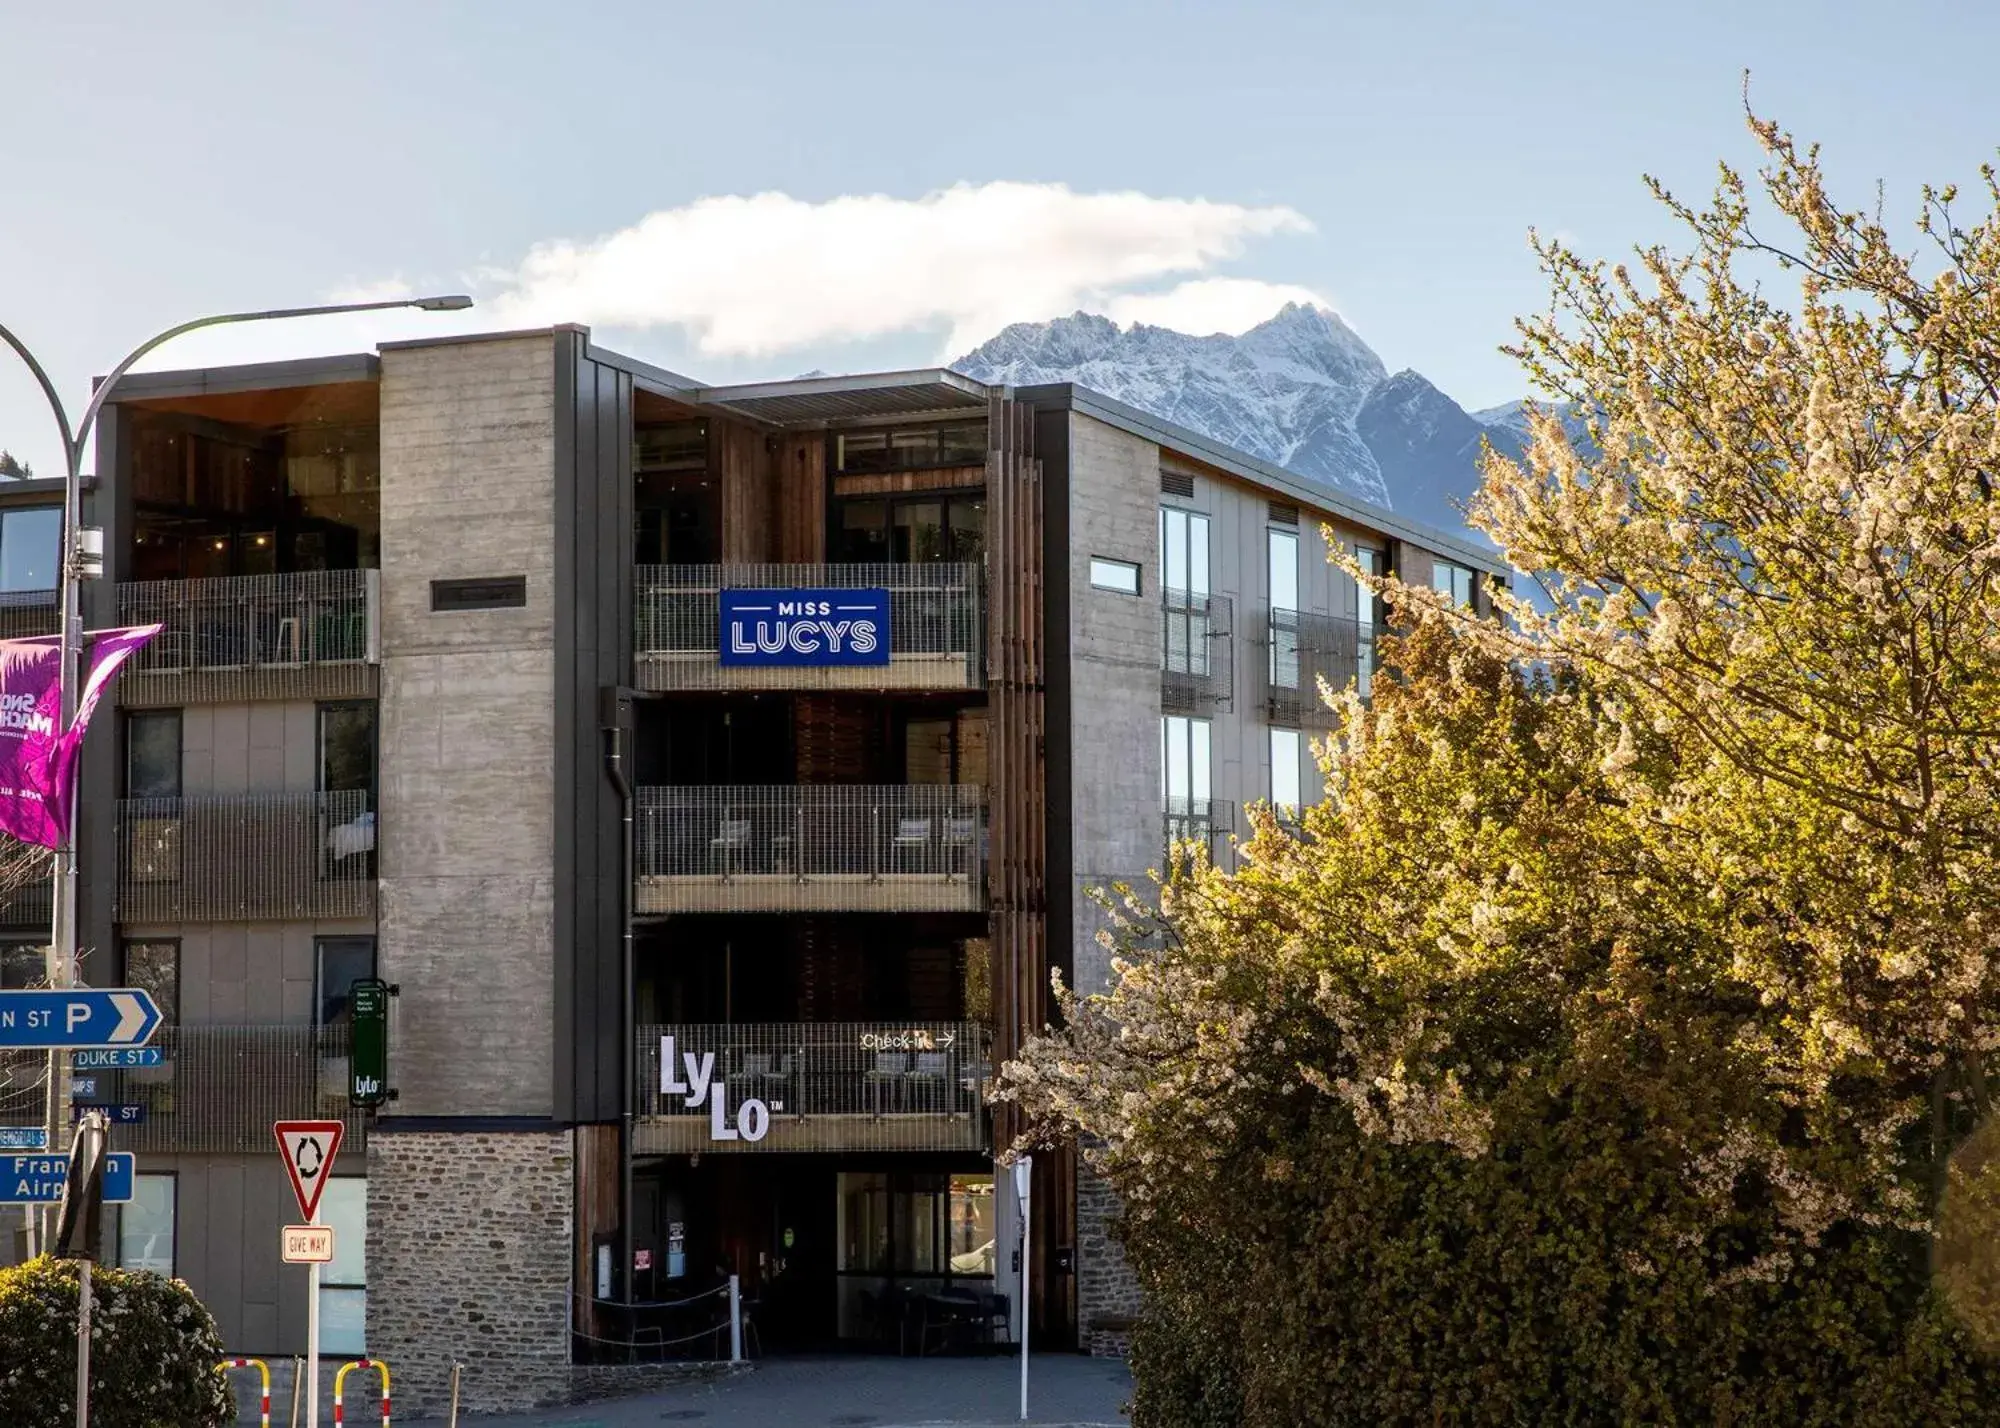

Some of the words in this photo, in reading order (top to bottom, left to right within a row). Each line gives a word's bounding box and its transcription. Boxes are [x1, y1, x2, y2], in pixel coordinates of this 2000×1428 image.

[778, 602, 831, 616] MISS
[732, 620, 877, 653] LUCYS
[27, 1010, 52, 1028] ST
[66, 1003, 92, 1034] P
[78, 1050, 120, 1065] DUKE
[127, 1049, 146, 1064] ST
[355, 1075, 378, 1097] LyLo
[121, 1107, 139, 1119] ST
[14, 1156, 118, 1174] Frann
[289, 1236, 307, 1253] GIVE
[310, 1236, 327, 1252] WAY
